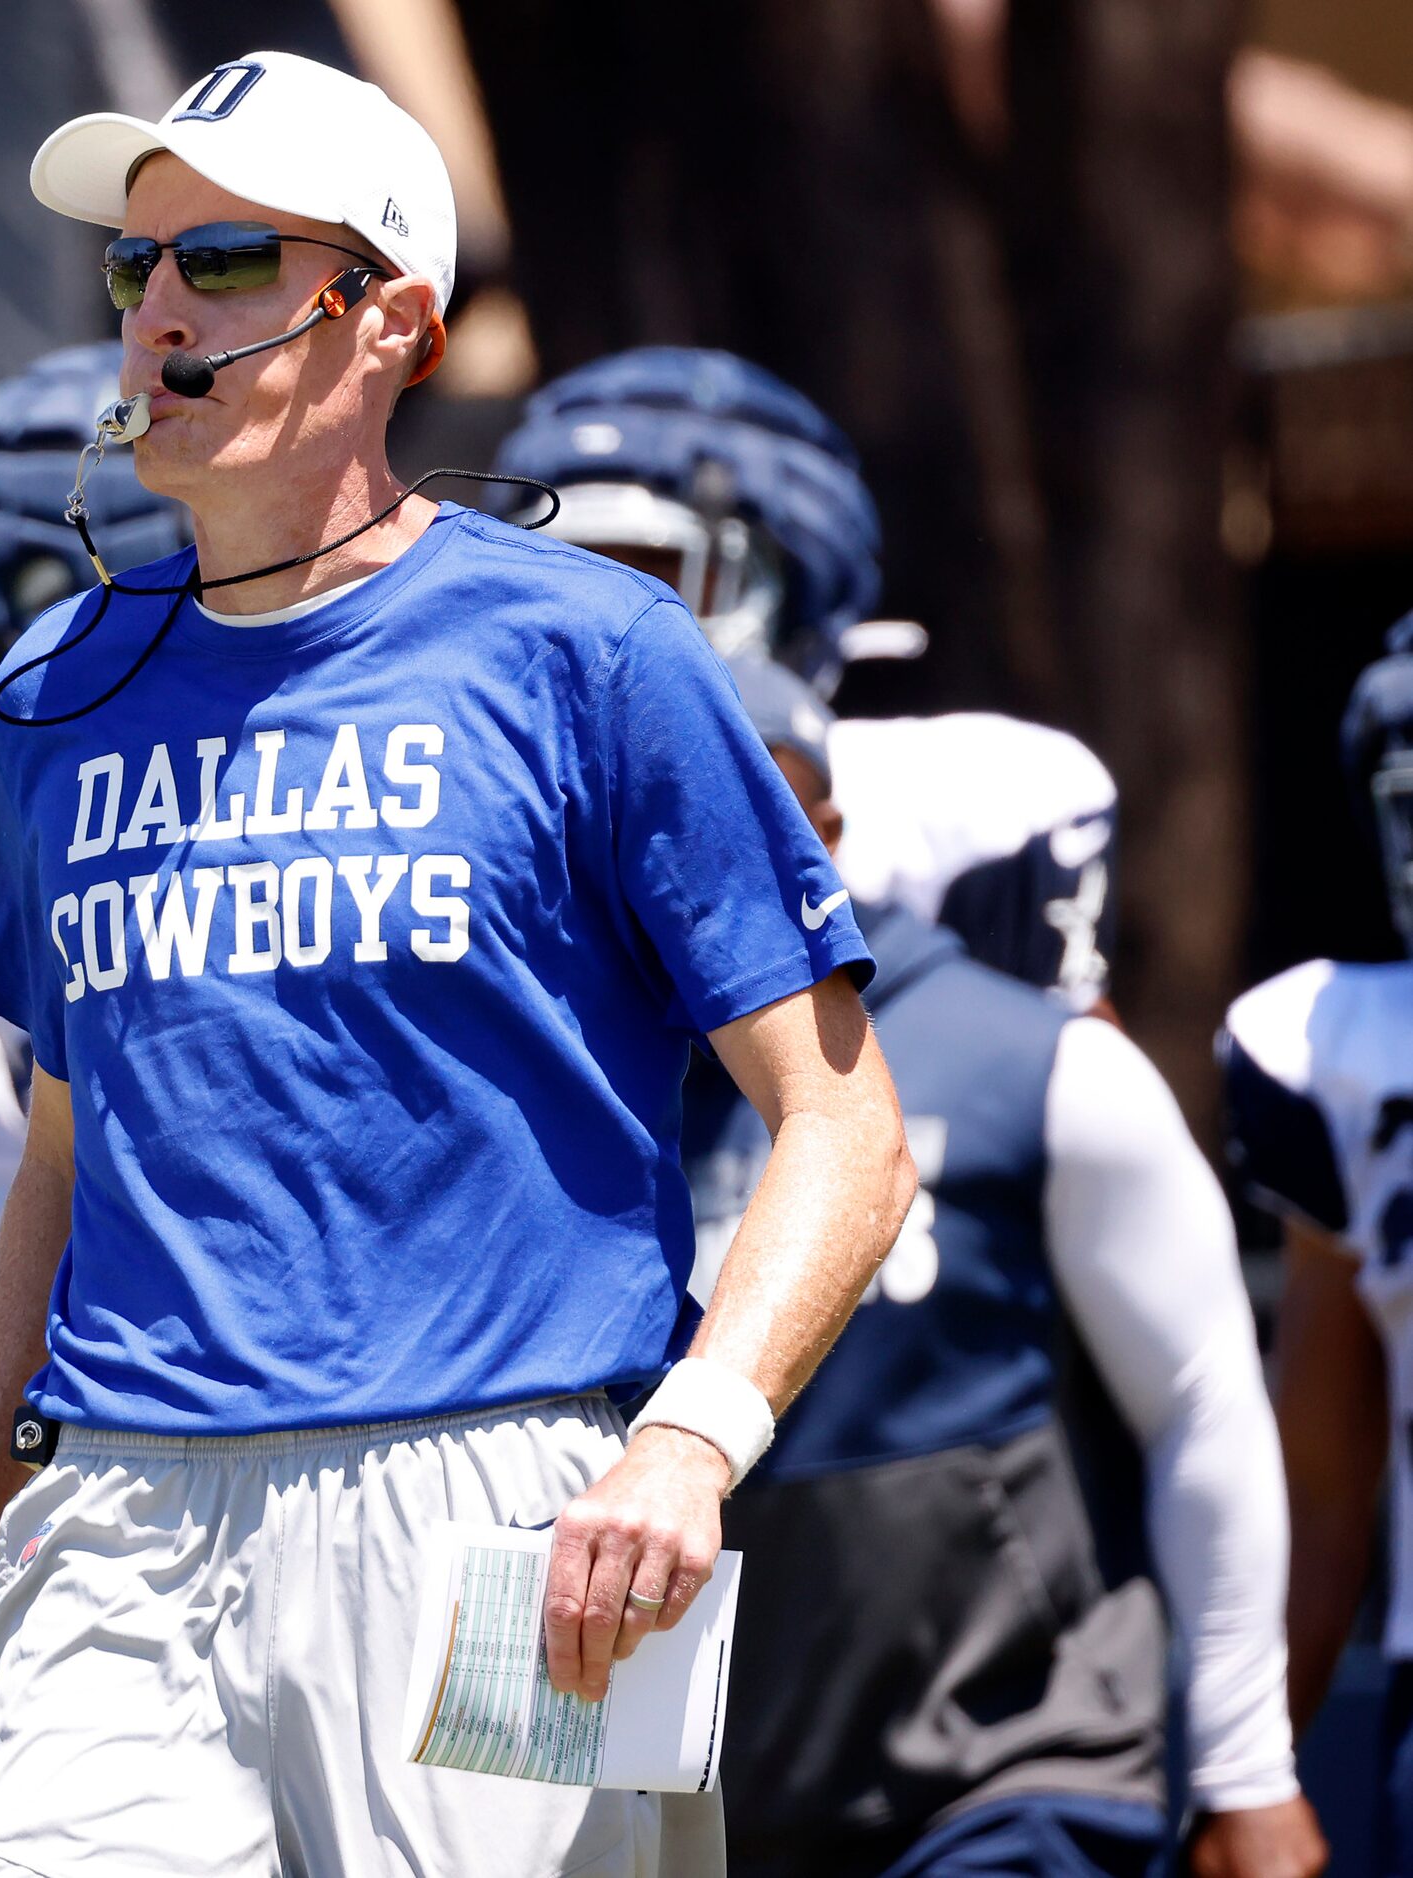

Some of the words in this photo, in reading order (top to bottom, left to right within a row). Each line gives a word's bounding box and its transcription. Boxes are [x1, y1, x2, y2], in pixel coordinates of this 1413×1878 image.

[172, 60, 266, 123] D
[68, 724, 444, 864] DALLAS
[51, 854, 471, 1003] COWBOYS
